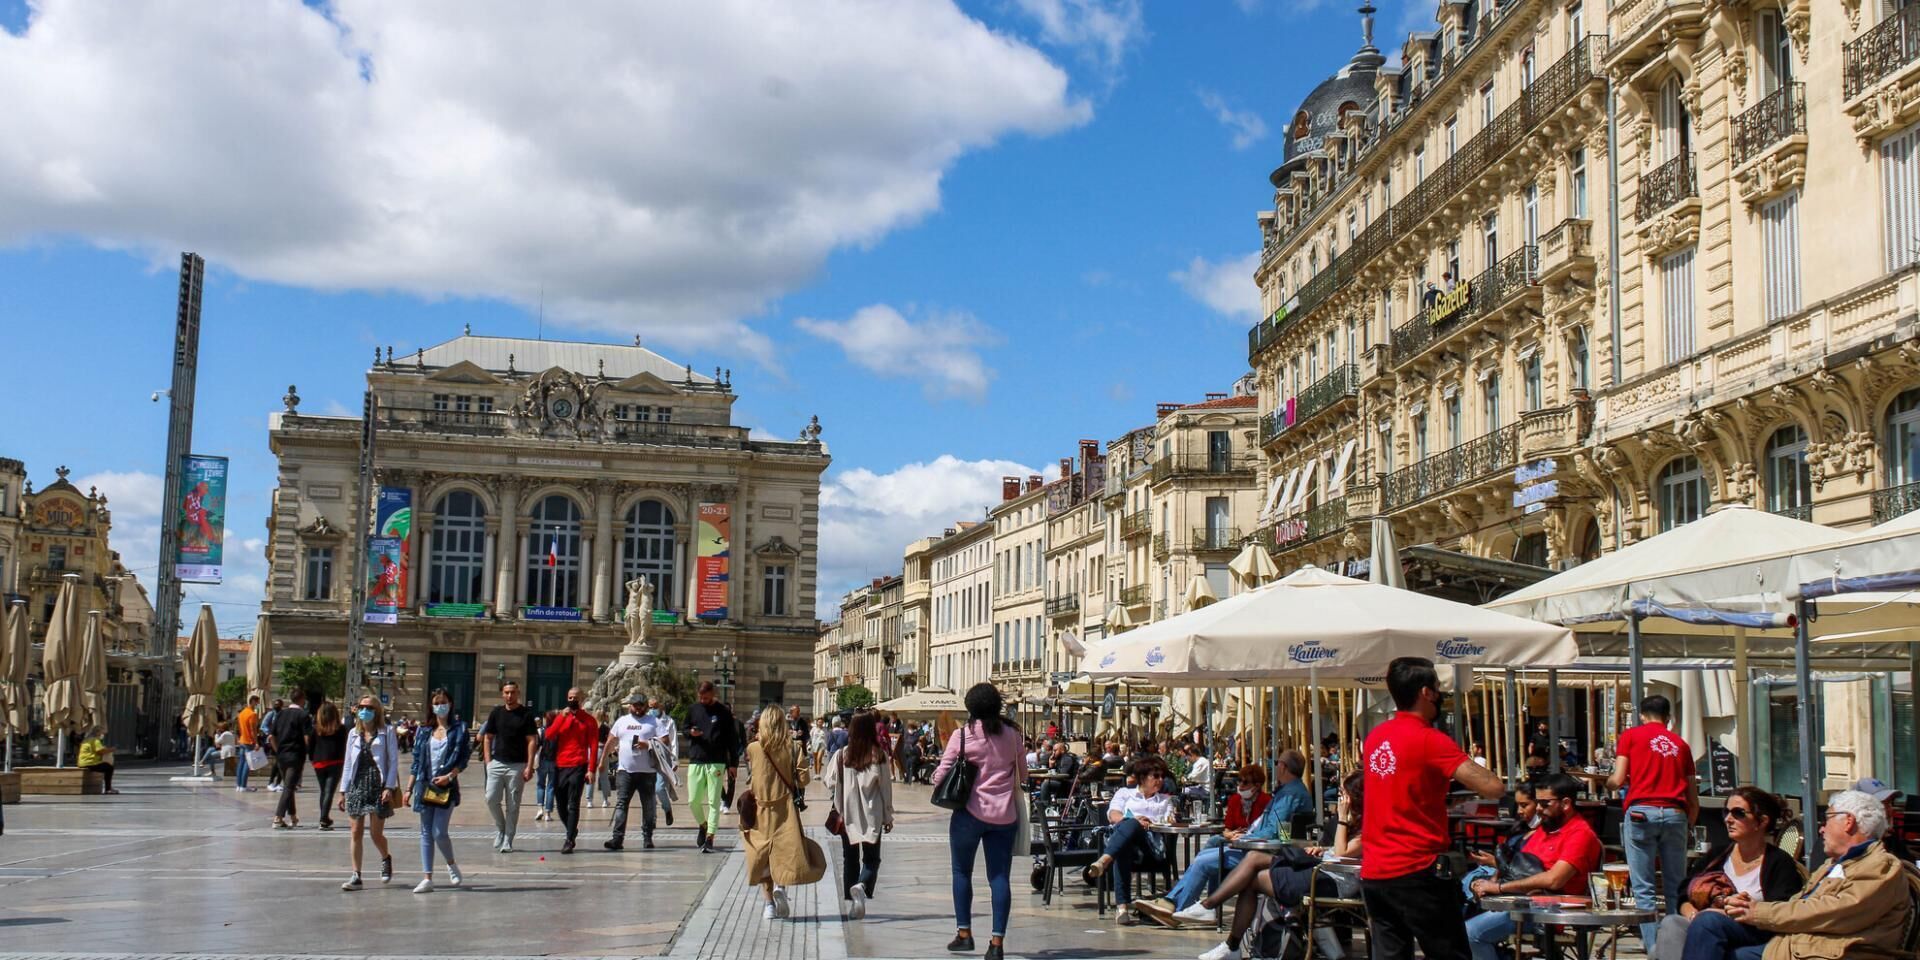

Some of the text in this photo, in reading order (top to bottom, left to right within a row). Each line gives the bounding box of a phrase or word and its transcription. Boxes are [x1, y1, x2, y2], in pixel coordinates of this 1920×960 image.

[1435, 281, 1469, 320] Gazette
[527, 608, 545, 616] Enfin
[1292, 644, 1340, 663] Laitière
[1440, 640, 1487, 659] Laitière
